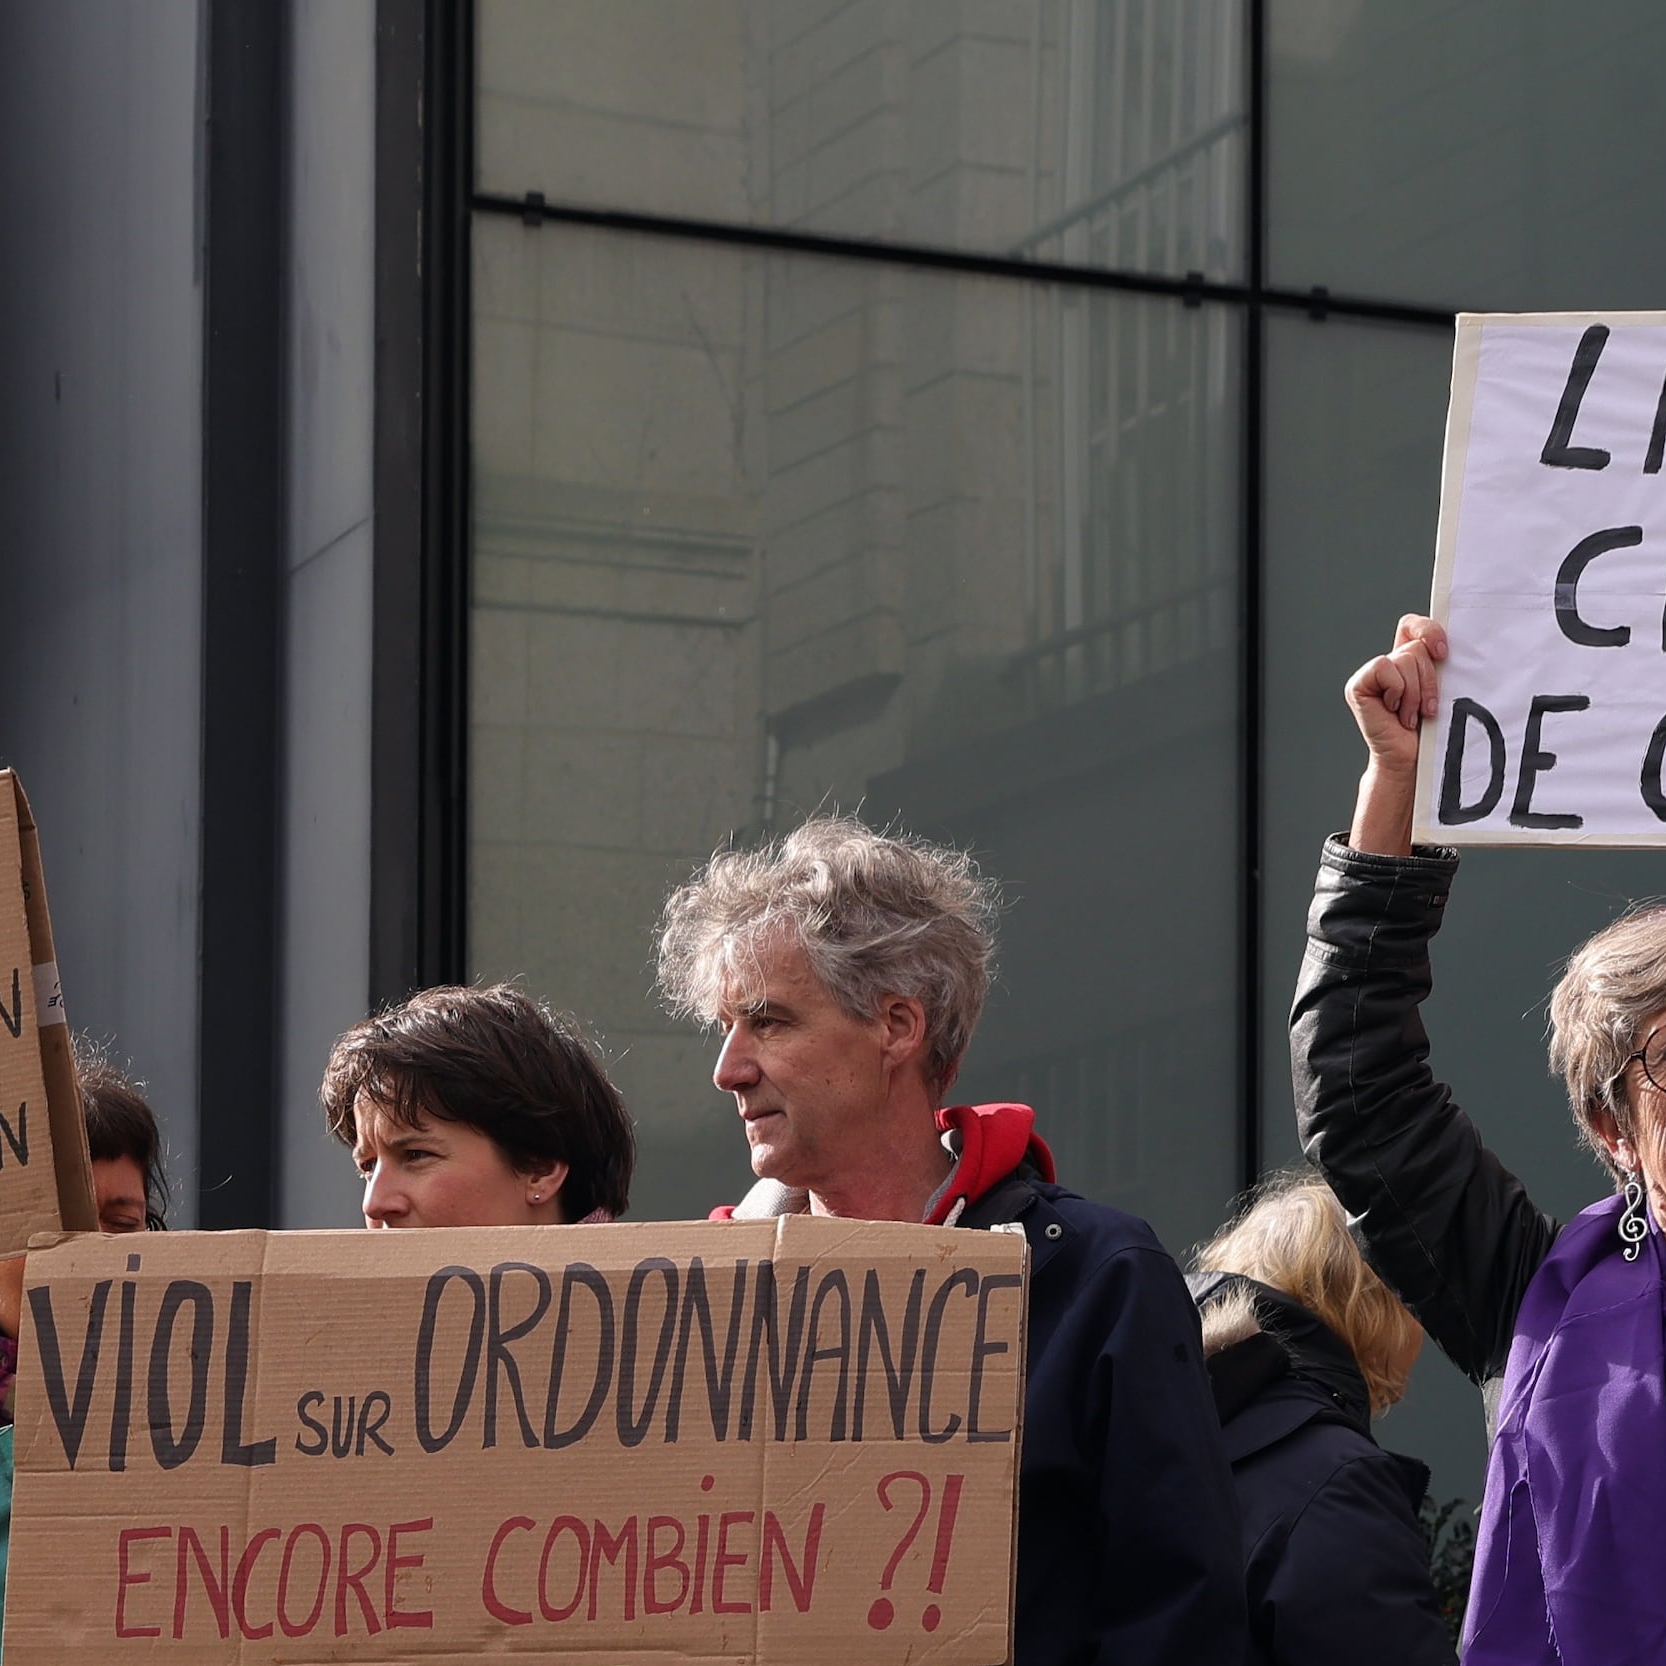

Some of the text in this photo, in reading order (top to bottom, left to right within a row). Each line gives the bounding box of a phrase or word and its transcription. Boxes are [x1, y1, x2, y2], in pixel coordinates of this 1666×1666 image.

[1438, 693, 1590, 830] DE
[27, 1254, 1022, 1472] VIOL SUR ORDONNANCE
[115, 1517, 433, 1640] ENCORE
[482, 1475, 825, 1626] COMBIEN
